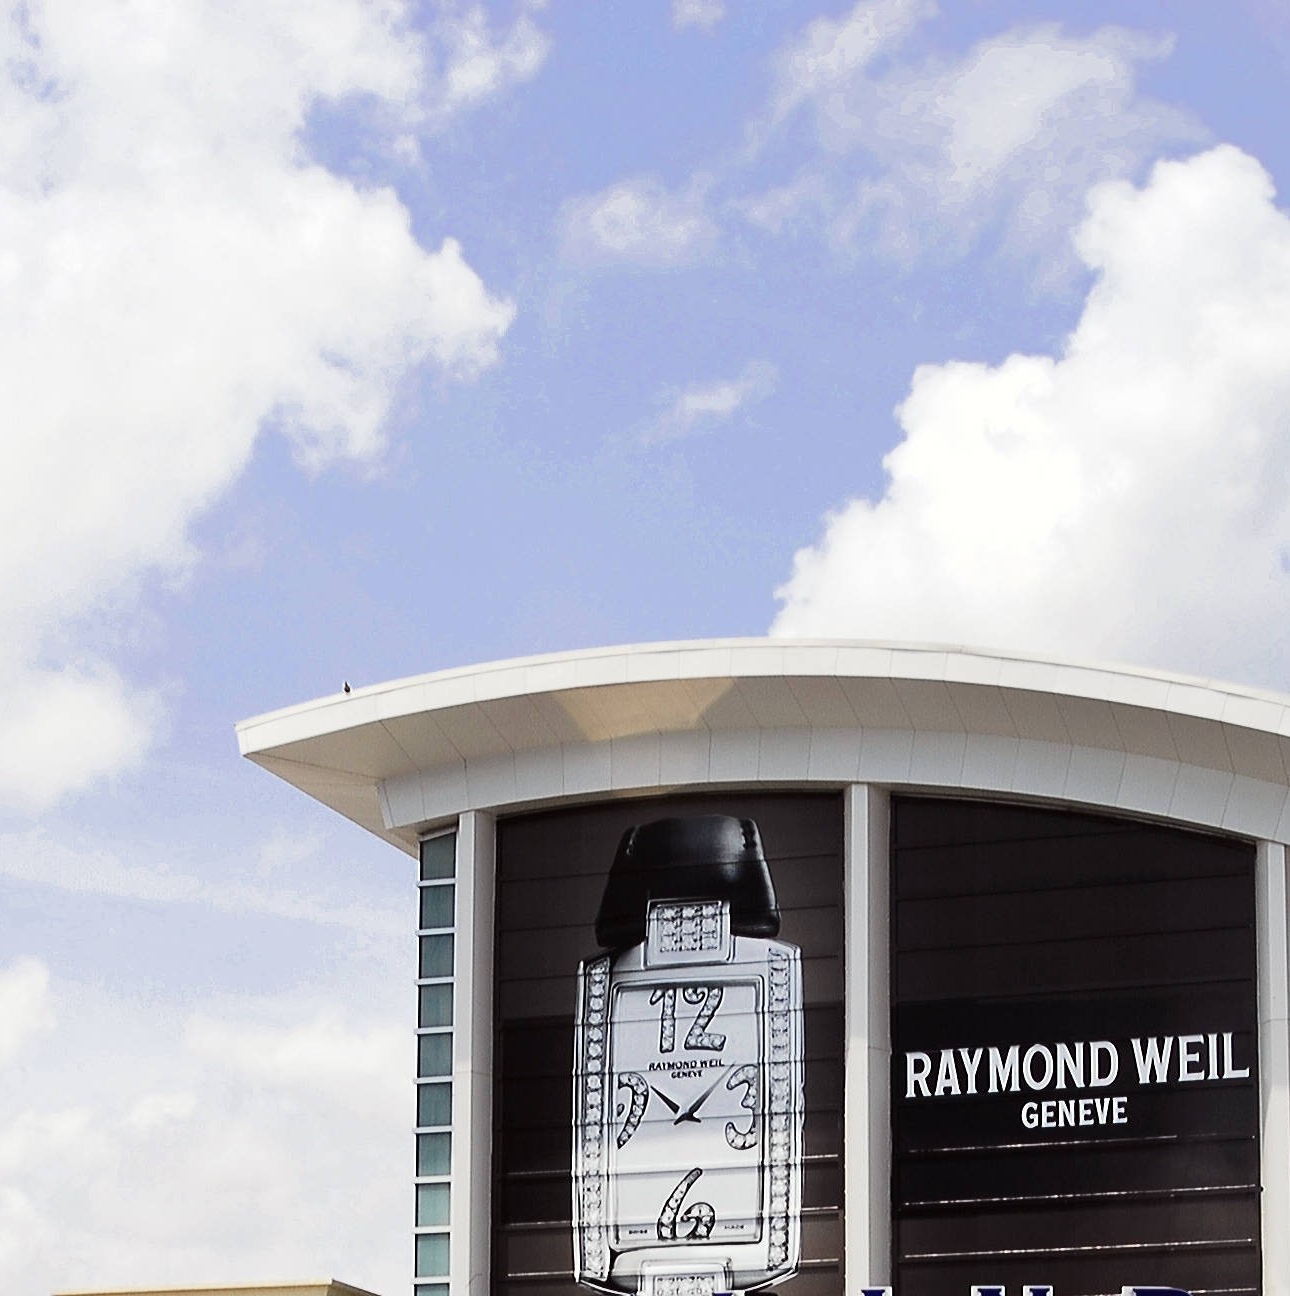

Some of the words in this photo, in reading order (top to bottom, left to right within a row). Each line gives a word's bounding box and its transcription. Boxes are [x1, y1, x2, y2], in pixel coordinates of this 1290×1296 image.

[648, 1060, 697, 1071] RAYMOND
[700, 1058, 725, 1068] WEIL
[670, 1070, 703, 1079] GENEVE
[904, 1039, 1119, 1099] RAYMOND
[1131, 1031, 1251, 1085] WEIL
[1020, 1096, 1129, 1129] GENEVE
